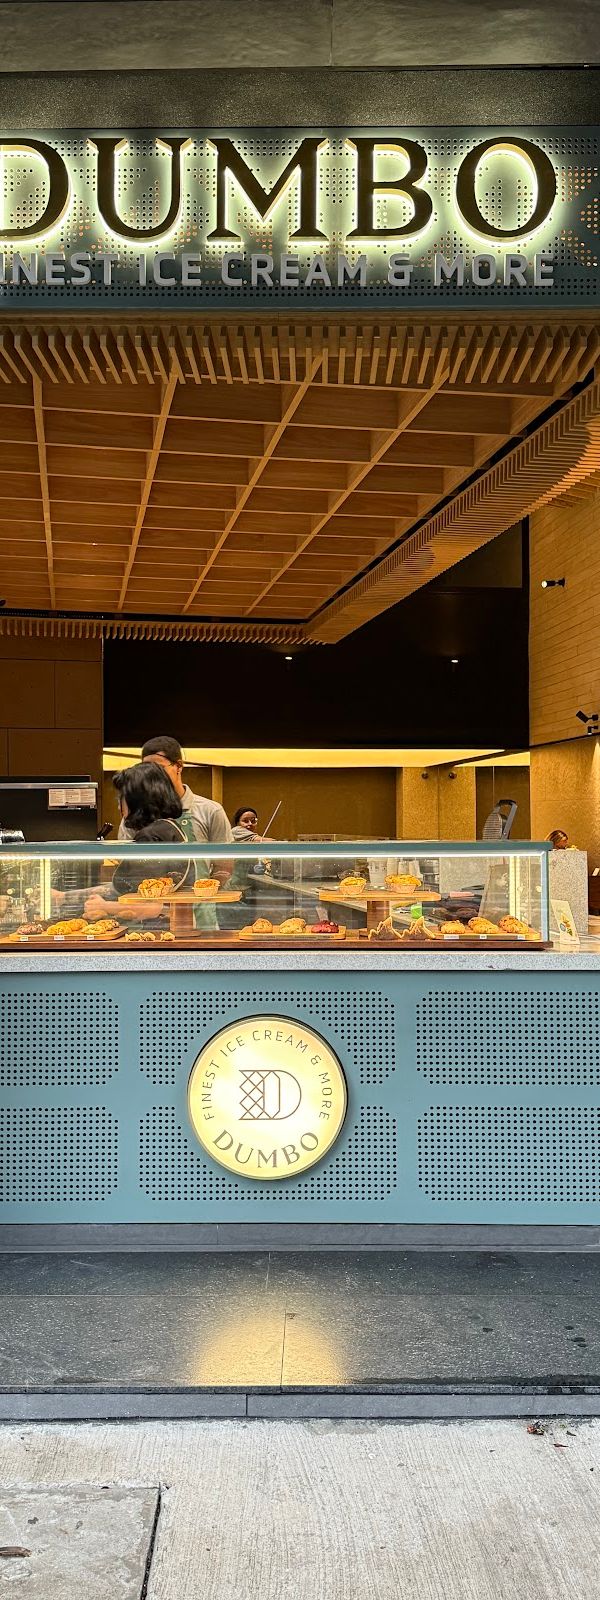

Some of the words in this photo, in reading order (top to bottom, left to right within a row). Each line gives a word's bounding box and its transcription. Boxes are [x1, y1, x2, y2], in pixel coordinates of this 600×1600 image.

[0, 136, 558, 241] DUMBO
[139, 252, 201, 287] ICE
[221, 252, 367, 287] CREAM
[387, 252, 414, 287] &
[433, 253, 555, 287] MORE
[201, 1059, 220, 1121] FINEST
[219, 1035, 246, 1057] ICE
[252, 1029, 309, 1053] CREAM
[310, 1054, 322, 1066] &
[318, 1071, 333, 1121] MORE
[212, 1129, 319, 1168] DUMBO
